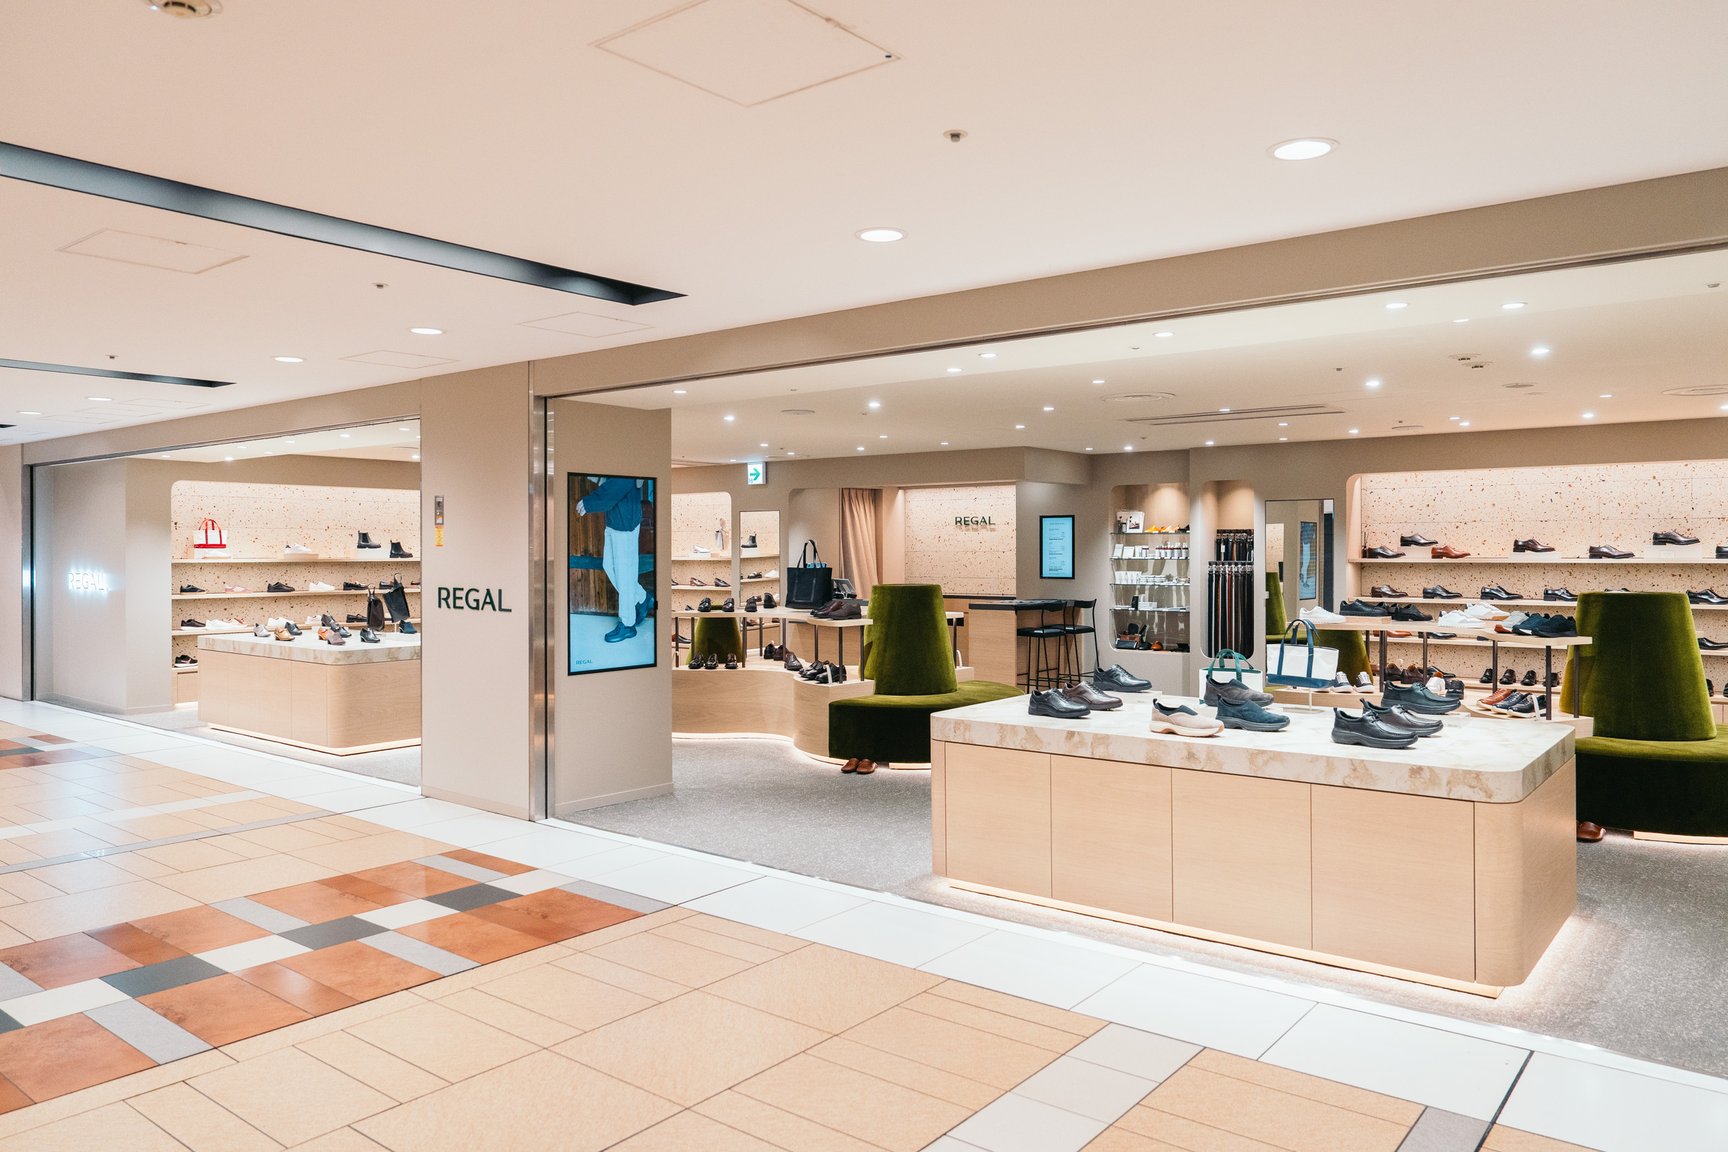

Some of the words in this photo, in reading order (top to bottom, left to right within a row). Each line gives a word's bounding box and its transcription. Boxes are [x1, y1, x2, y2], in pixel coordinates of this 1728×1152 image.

[954, 516, 996, 526] REGAL
[67, 572, 105, 591] REGAL
[437, 586, 512, 613] REGAL
